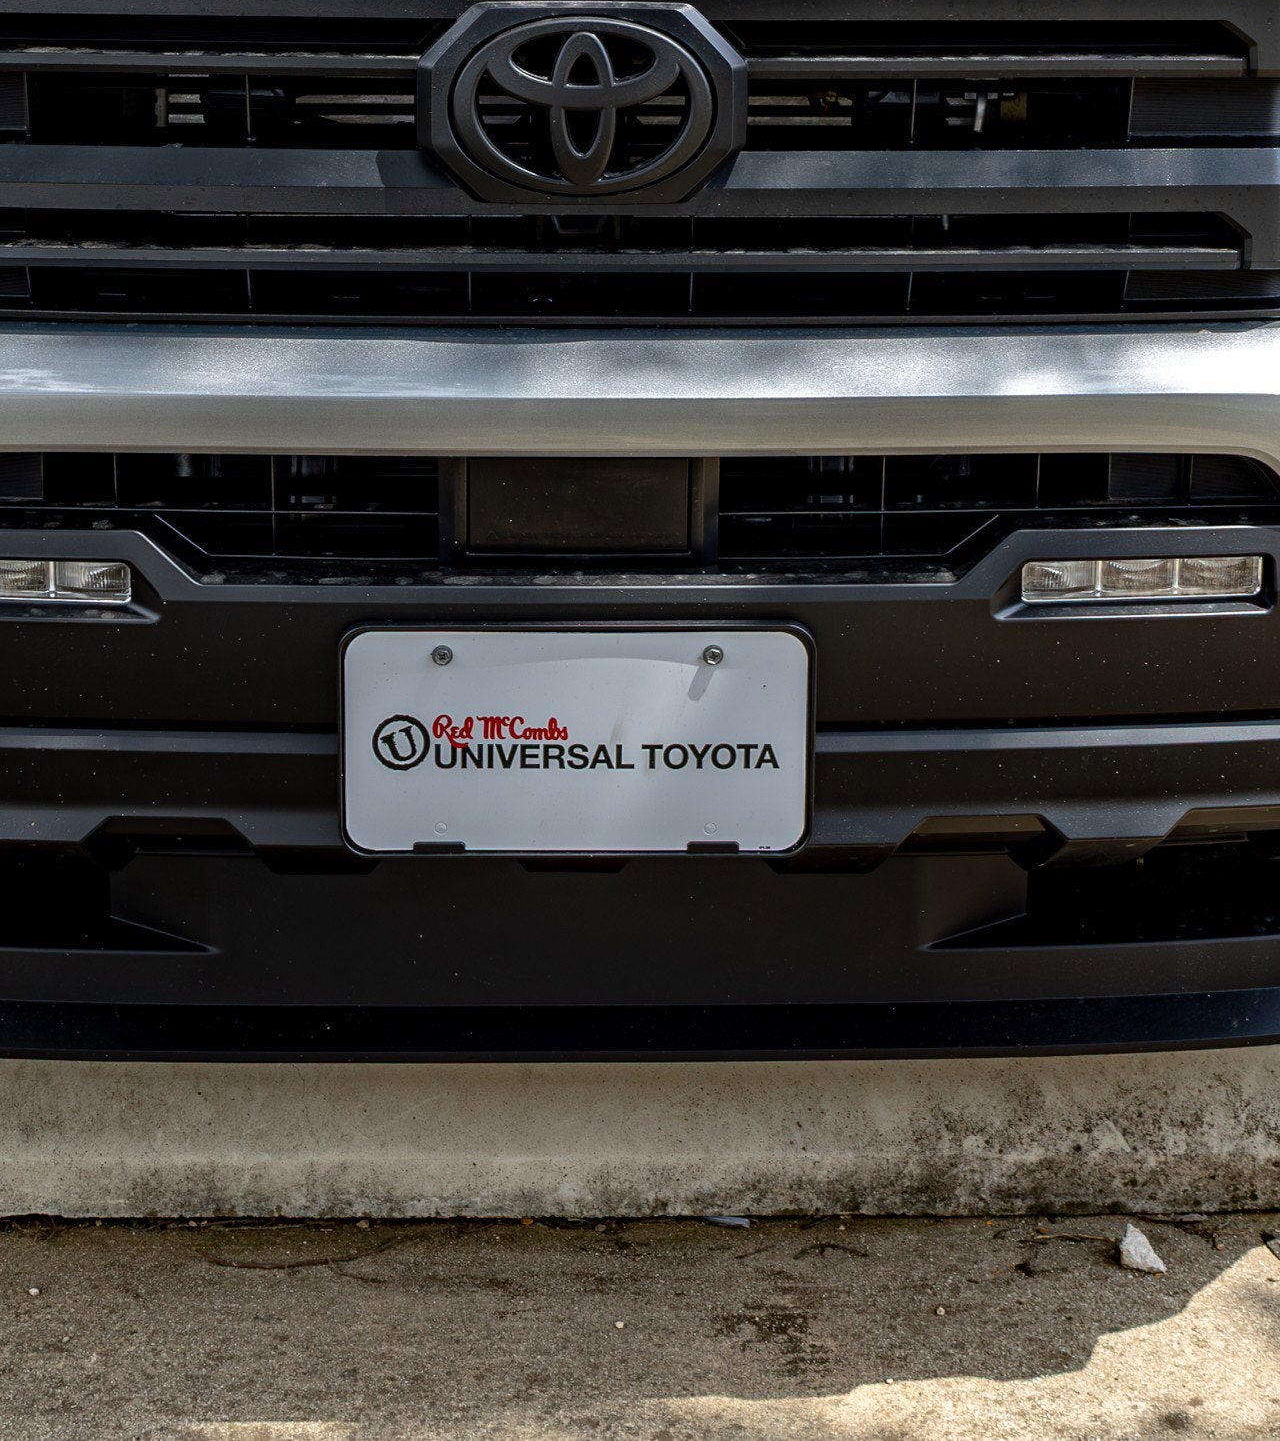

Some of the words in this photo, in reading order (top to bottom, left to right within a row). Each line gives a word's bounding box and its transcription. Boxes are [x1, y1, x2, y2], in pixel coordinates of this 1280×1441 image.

[431, 713, 476, 749] Red
[476, 714, 569, 741] McCombs
[433, 742, 635, 770] UNIVERSAL
[641, 742, 781, 770] TOYOTA
